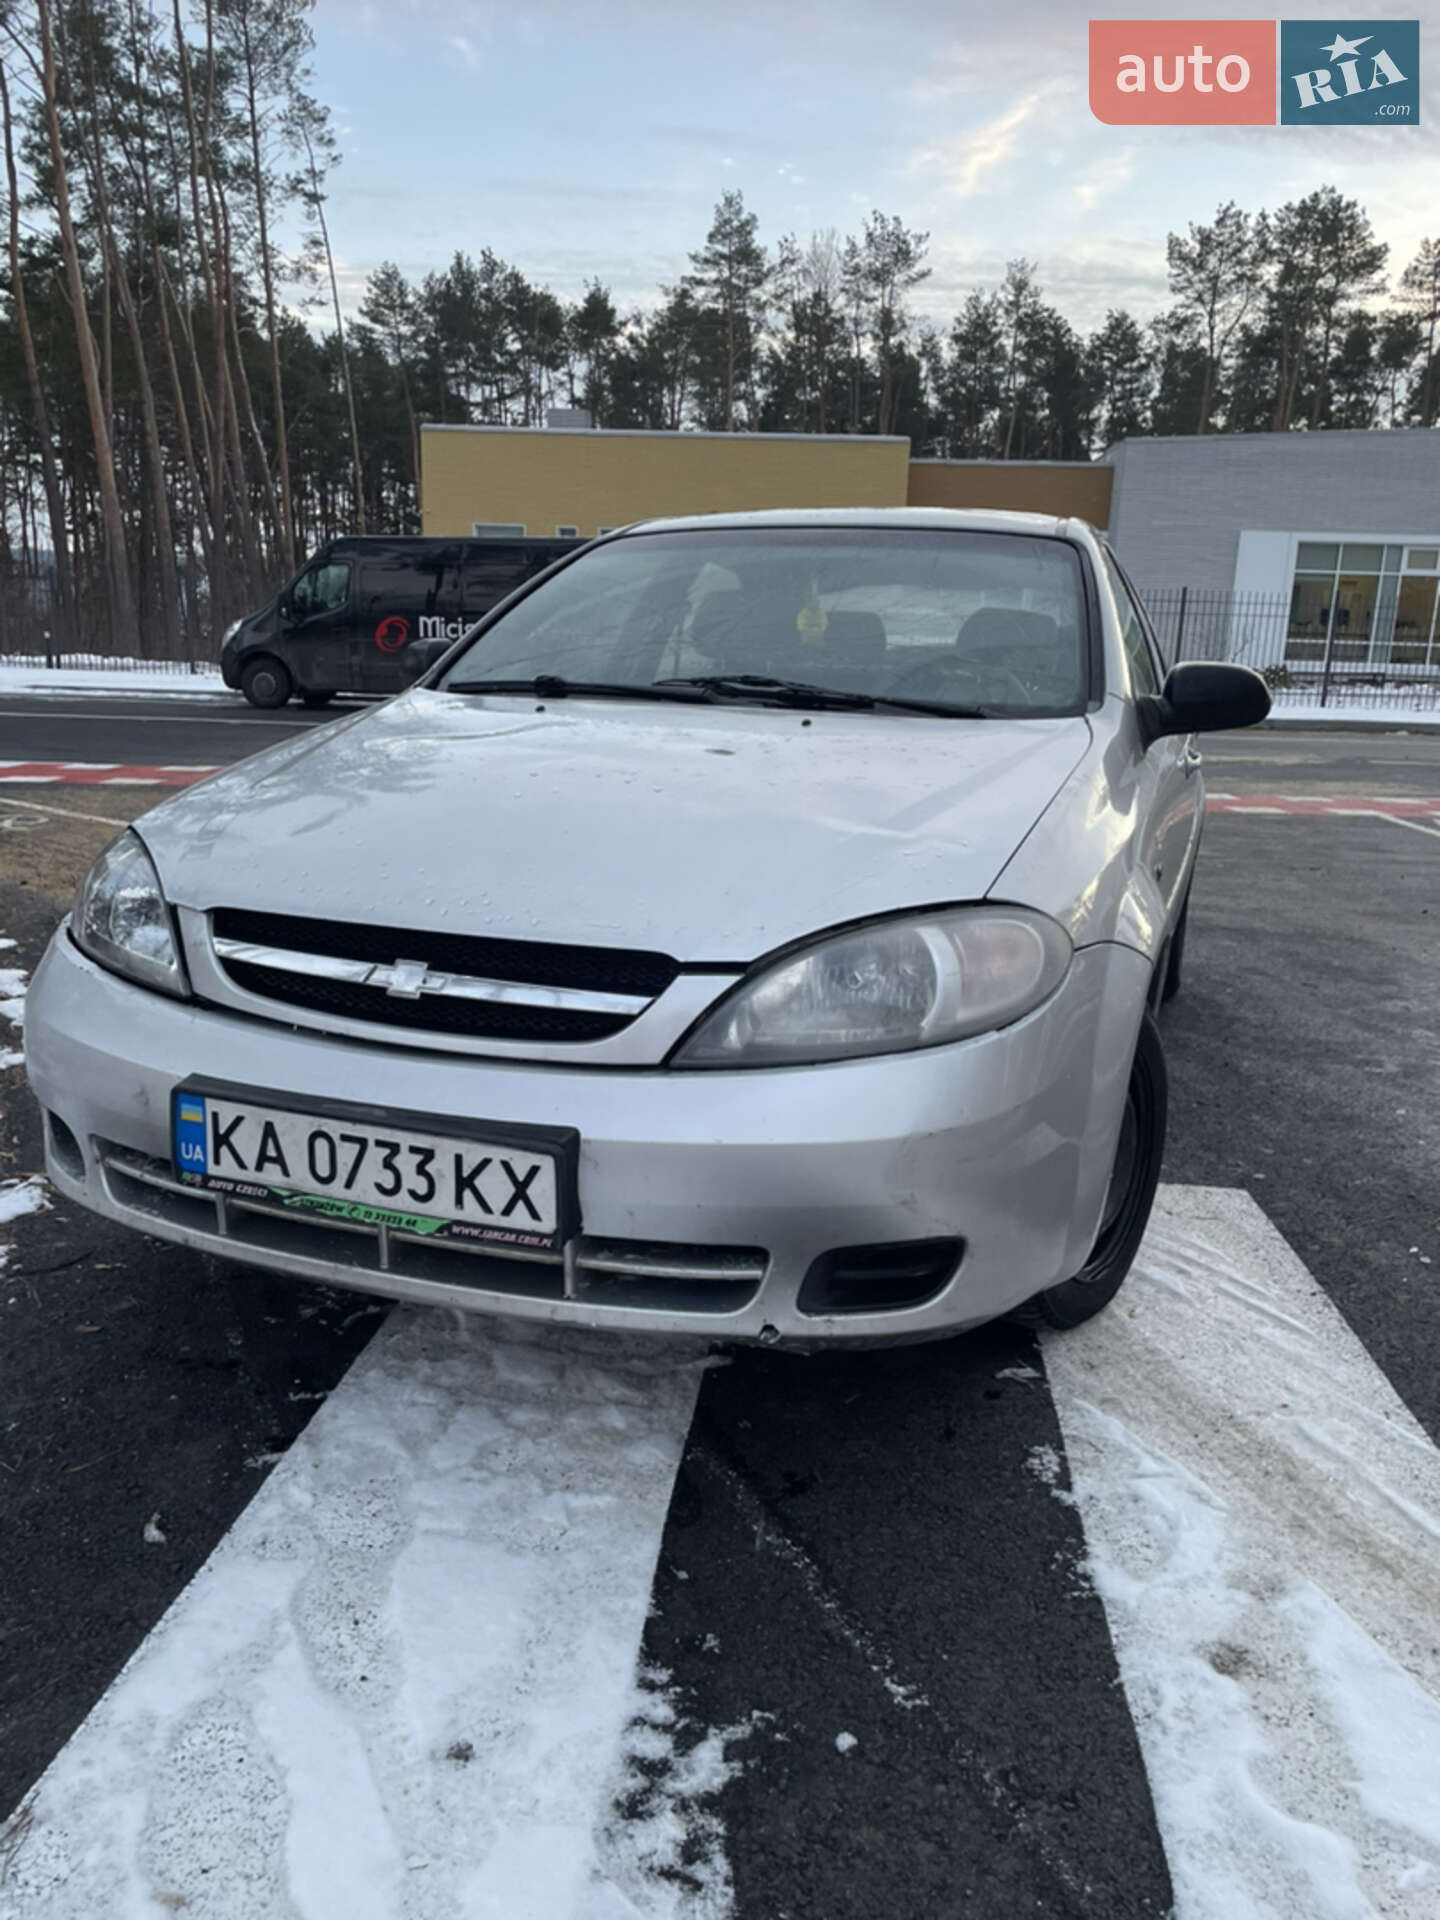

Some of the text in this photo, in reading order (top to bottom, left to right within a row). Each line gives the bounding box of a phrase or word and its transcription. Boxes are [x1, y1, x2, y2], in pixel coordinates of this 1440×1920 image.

[181, 1141, 205, 1163] UA
[211, 1110, 543, 1222] KA 0733 KX
